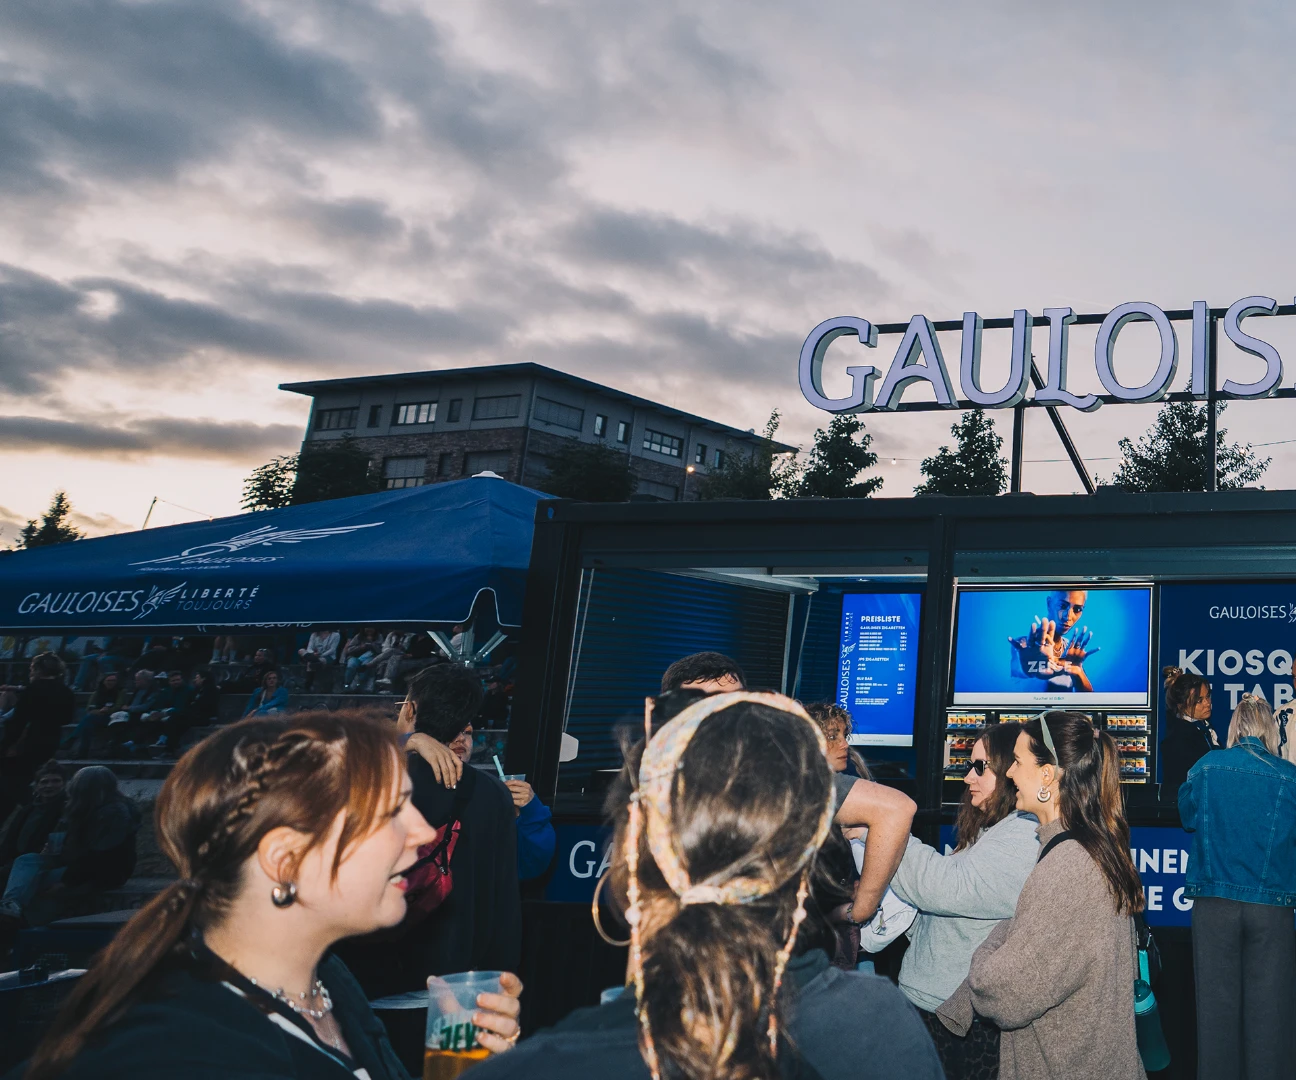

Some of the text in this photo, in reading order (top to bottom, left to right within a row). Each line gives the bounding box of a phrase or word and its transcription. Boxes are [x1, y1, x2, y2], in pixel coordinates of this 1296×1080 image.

[180, 585, 259, 599] LIBERTÉ
[17, 589, 144, 616] GAULOISES
[176, 599, 252, 611] TOUJOURS
[860, 615, 901, 623] PREISLISTE
[1209, 605, 1287, 620] GAULOISES
